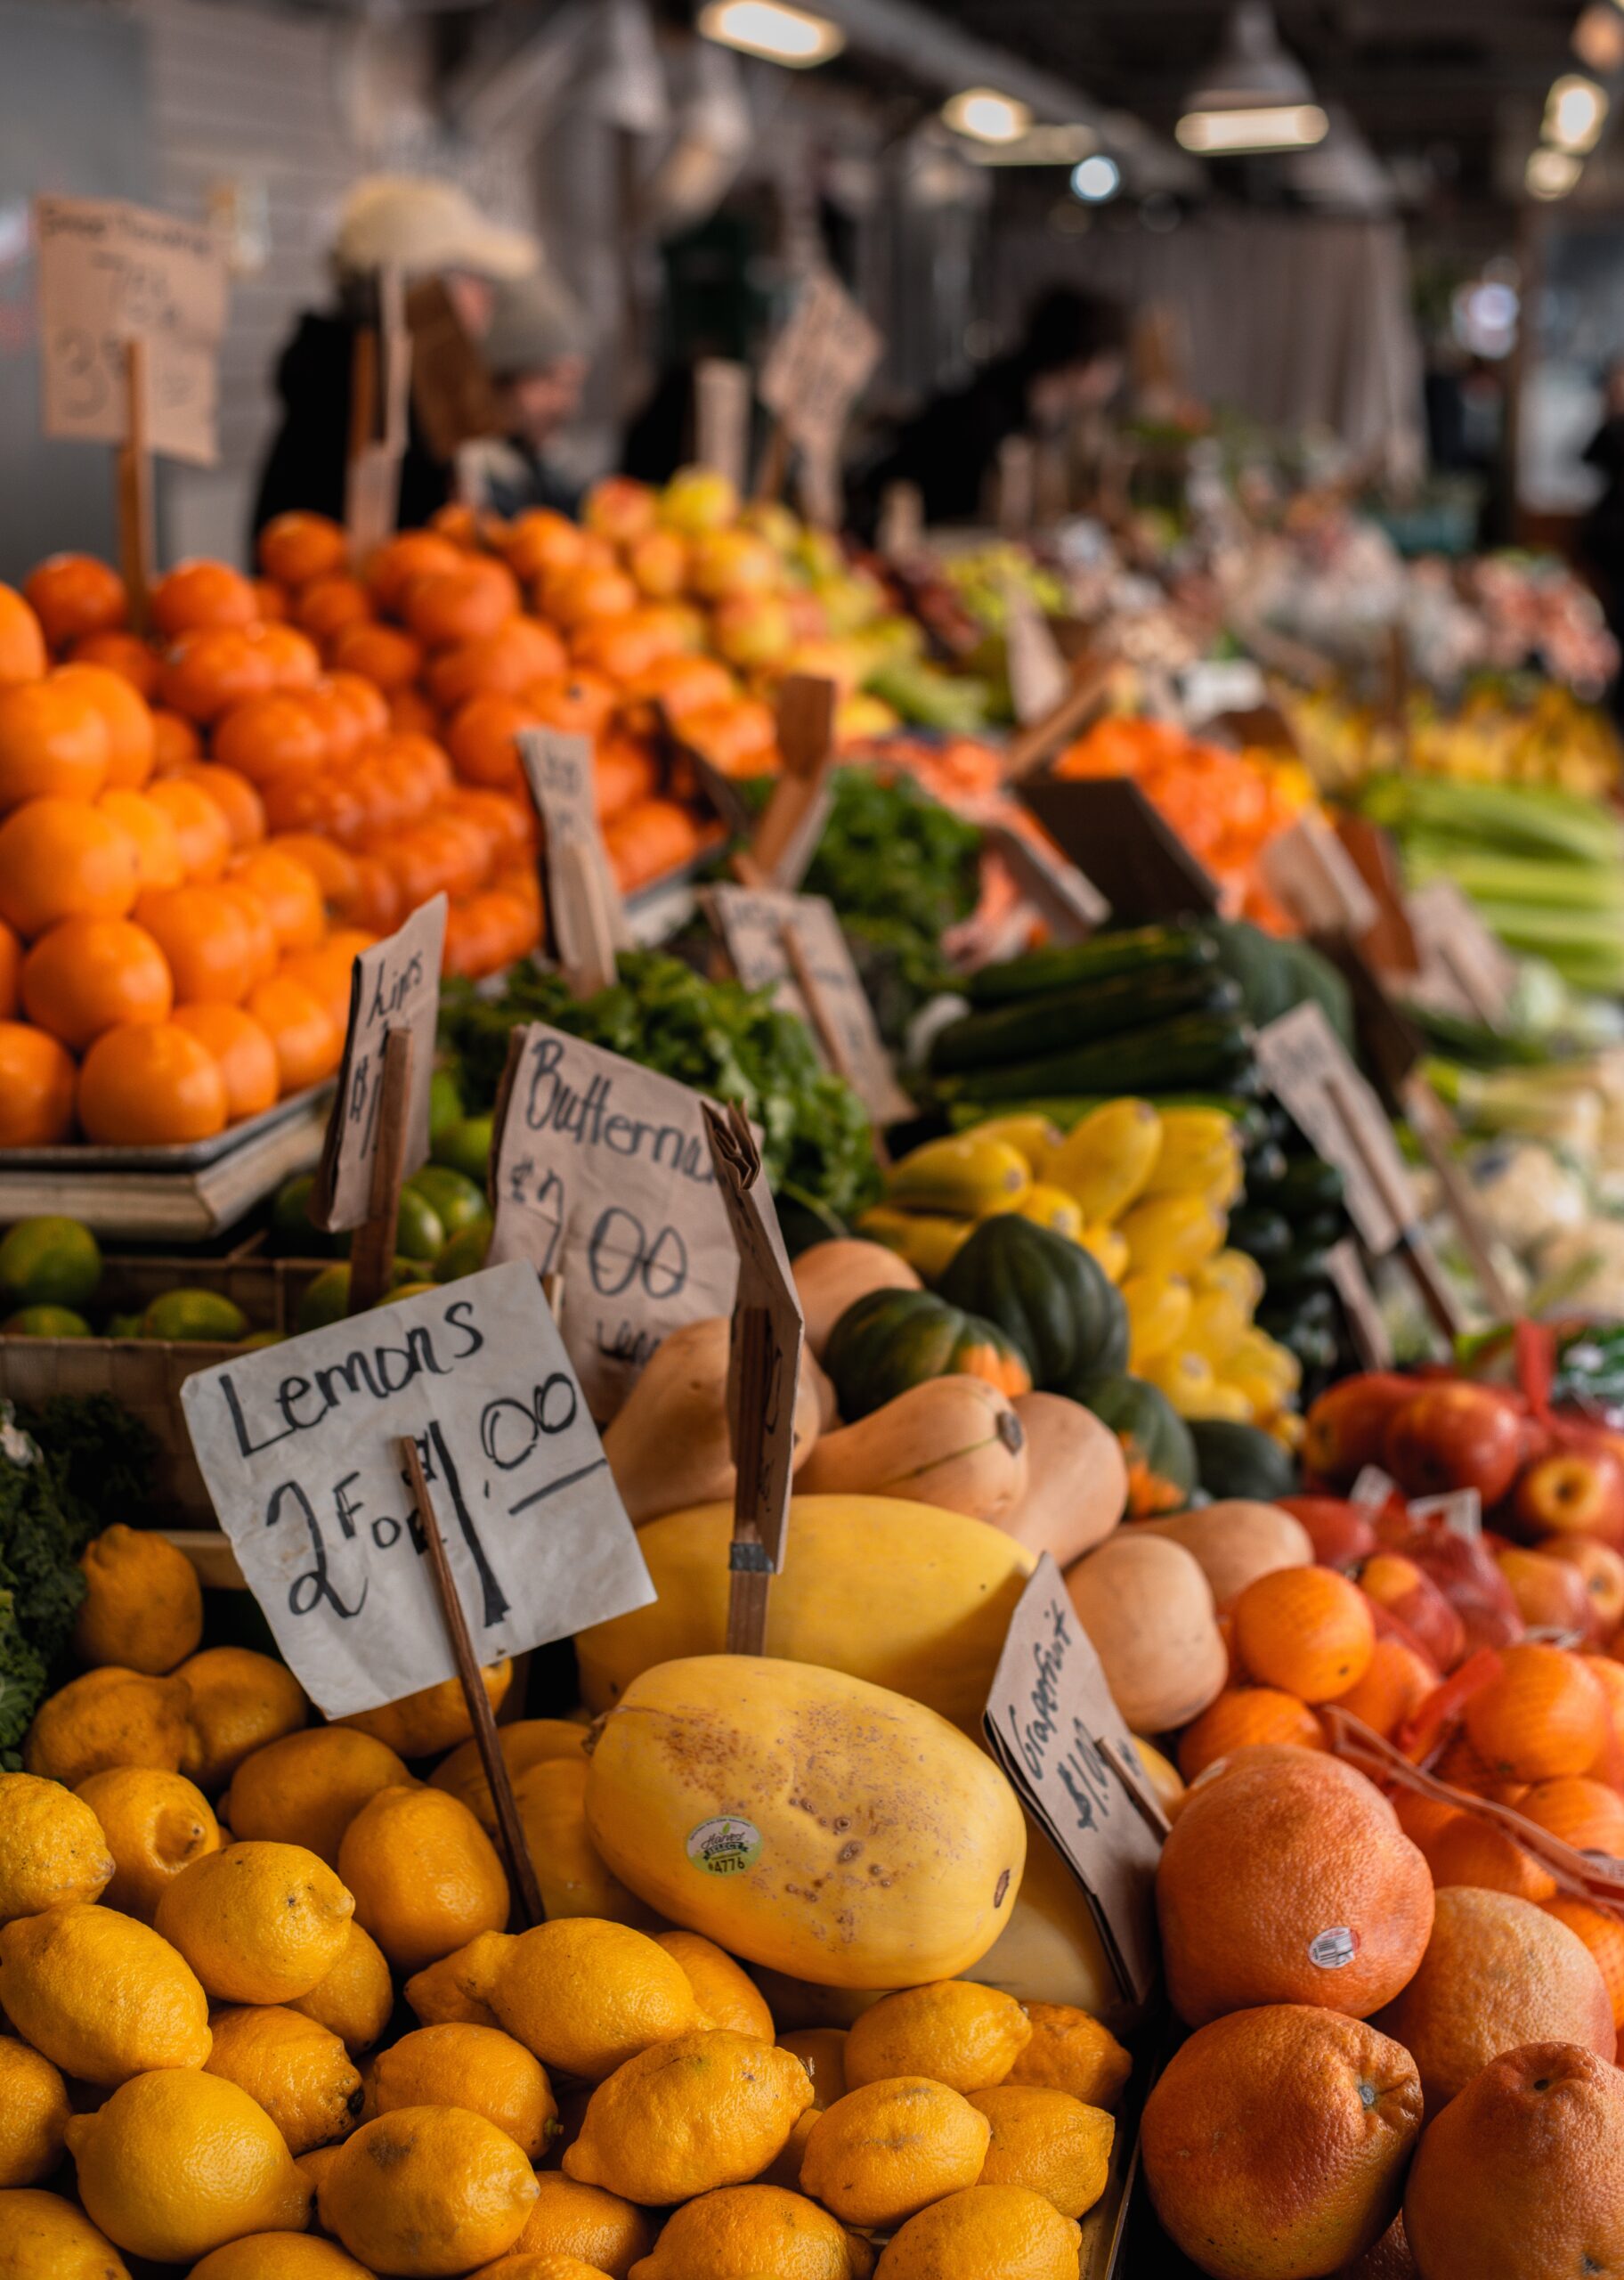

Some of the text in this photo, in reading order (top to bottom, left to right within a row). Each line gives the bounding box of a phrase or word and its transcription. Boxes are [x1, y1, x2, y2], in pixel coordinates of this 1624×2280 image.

[525, 1038, 713, 1184] Butternu
[219, 1301, 484, 1458] Lemons
[265, 1479, 369, 1619] 2
[1007, 1599, 1072, 1780] Grapefruit
